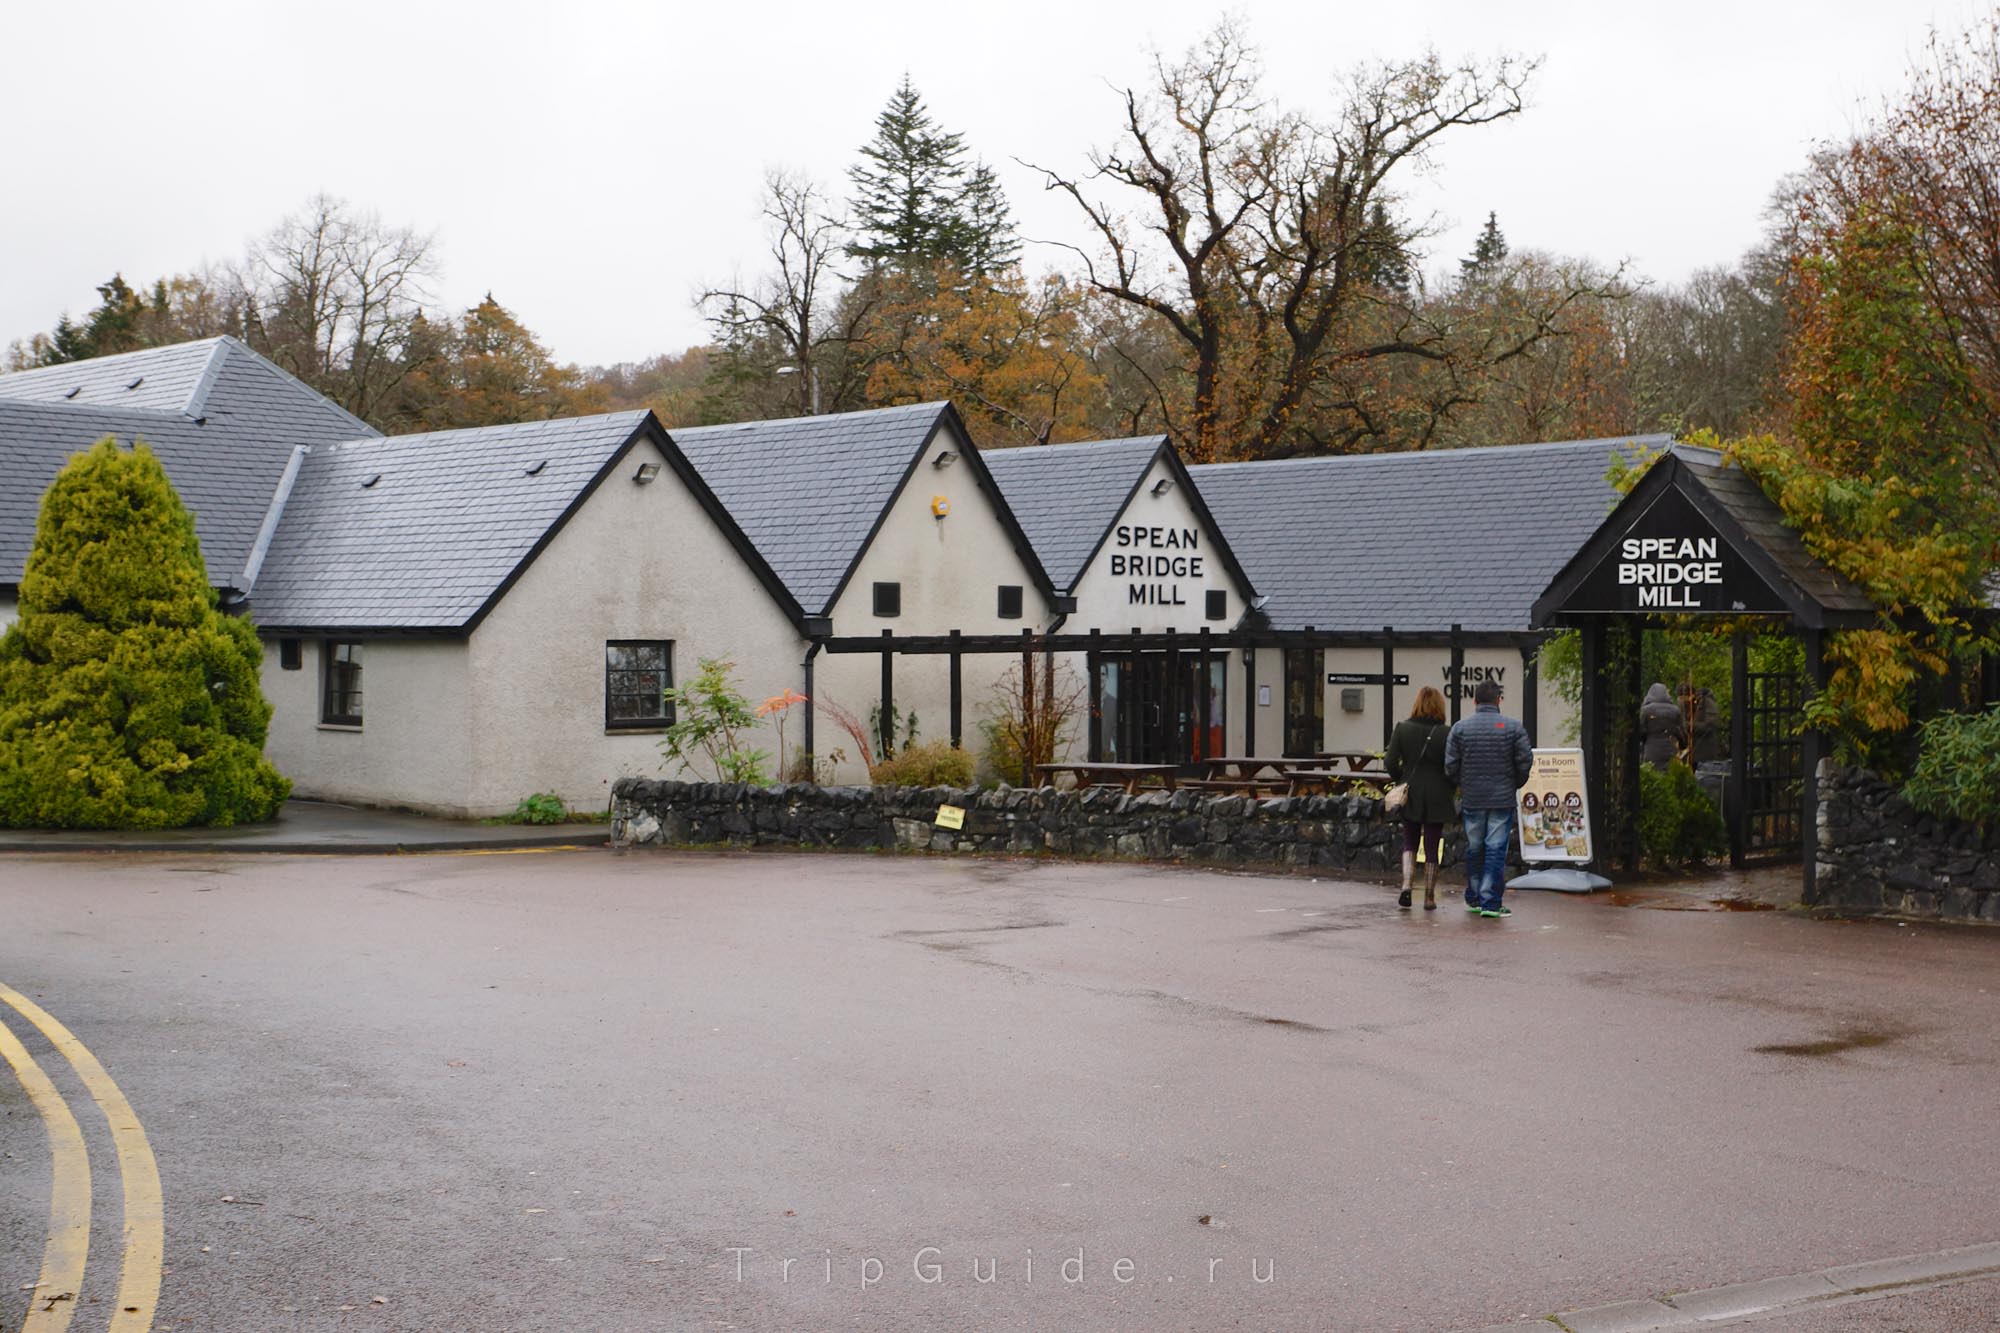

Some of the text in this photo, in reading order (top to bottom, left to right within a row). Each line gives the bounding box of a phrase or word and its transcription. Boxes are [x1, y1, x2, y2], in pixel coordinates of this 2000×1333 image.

[1116, 526, 1198, 549] SPEAN
[1622, 537, 1717, 560] SPEAN
[1111, 555, 1203, 577] BRIDGE
[1618, 562, 1723, 585] BRIDGE
[1129, 584, 1186, 605] MILL
[1638, 586, 1701, 607] MILL
[1537, 758, 1551, 766] Tea
[1552, 757, 1575, 766] Room
